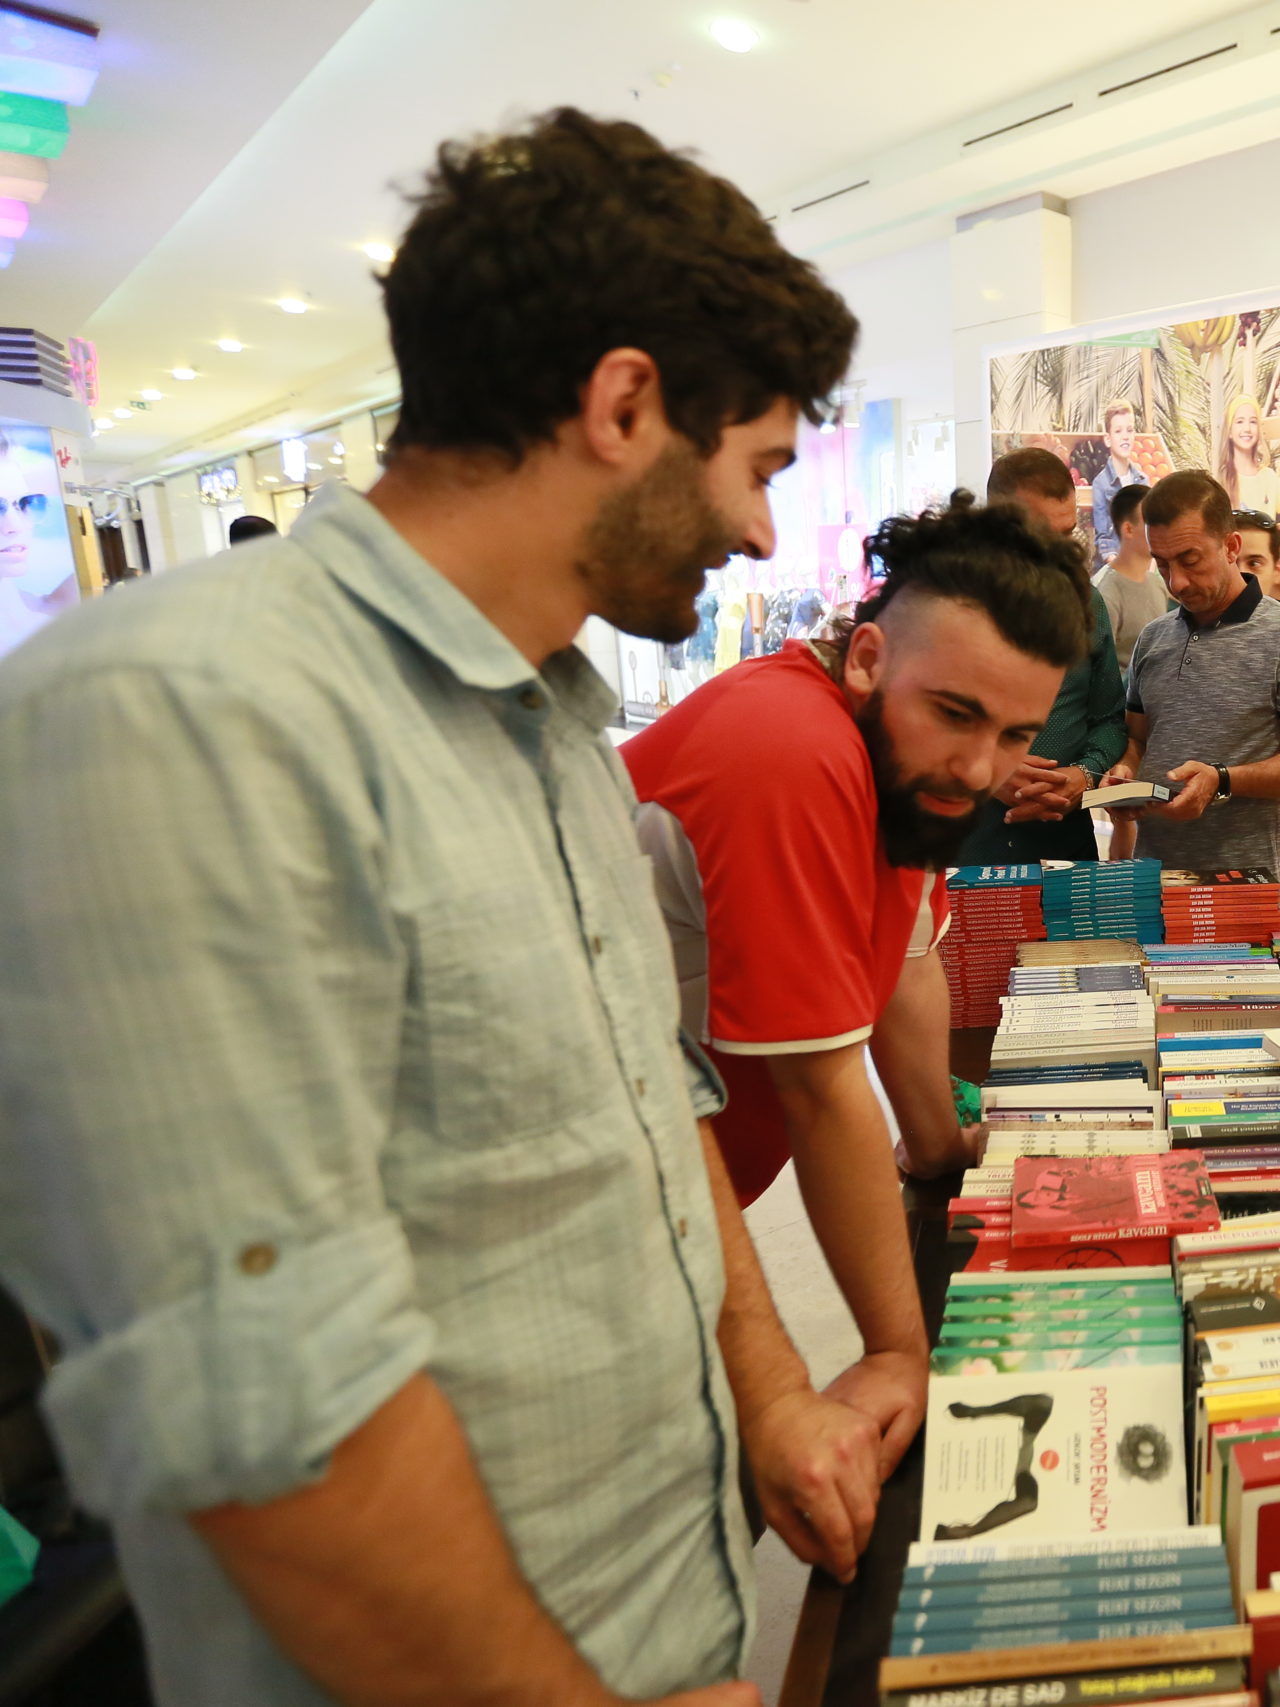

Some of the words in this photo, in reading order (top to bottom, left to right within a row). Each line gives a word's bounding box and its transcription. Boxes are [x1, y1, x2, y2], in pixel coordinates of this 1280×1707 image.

[1090, 1385, 1112, 1533] POSTMODERNİZM
[990, 1685, 1021, 1703] DE
[1022, 1681, 1066, 1704] SAD
